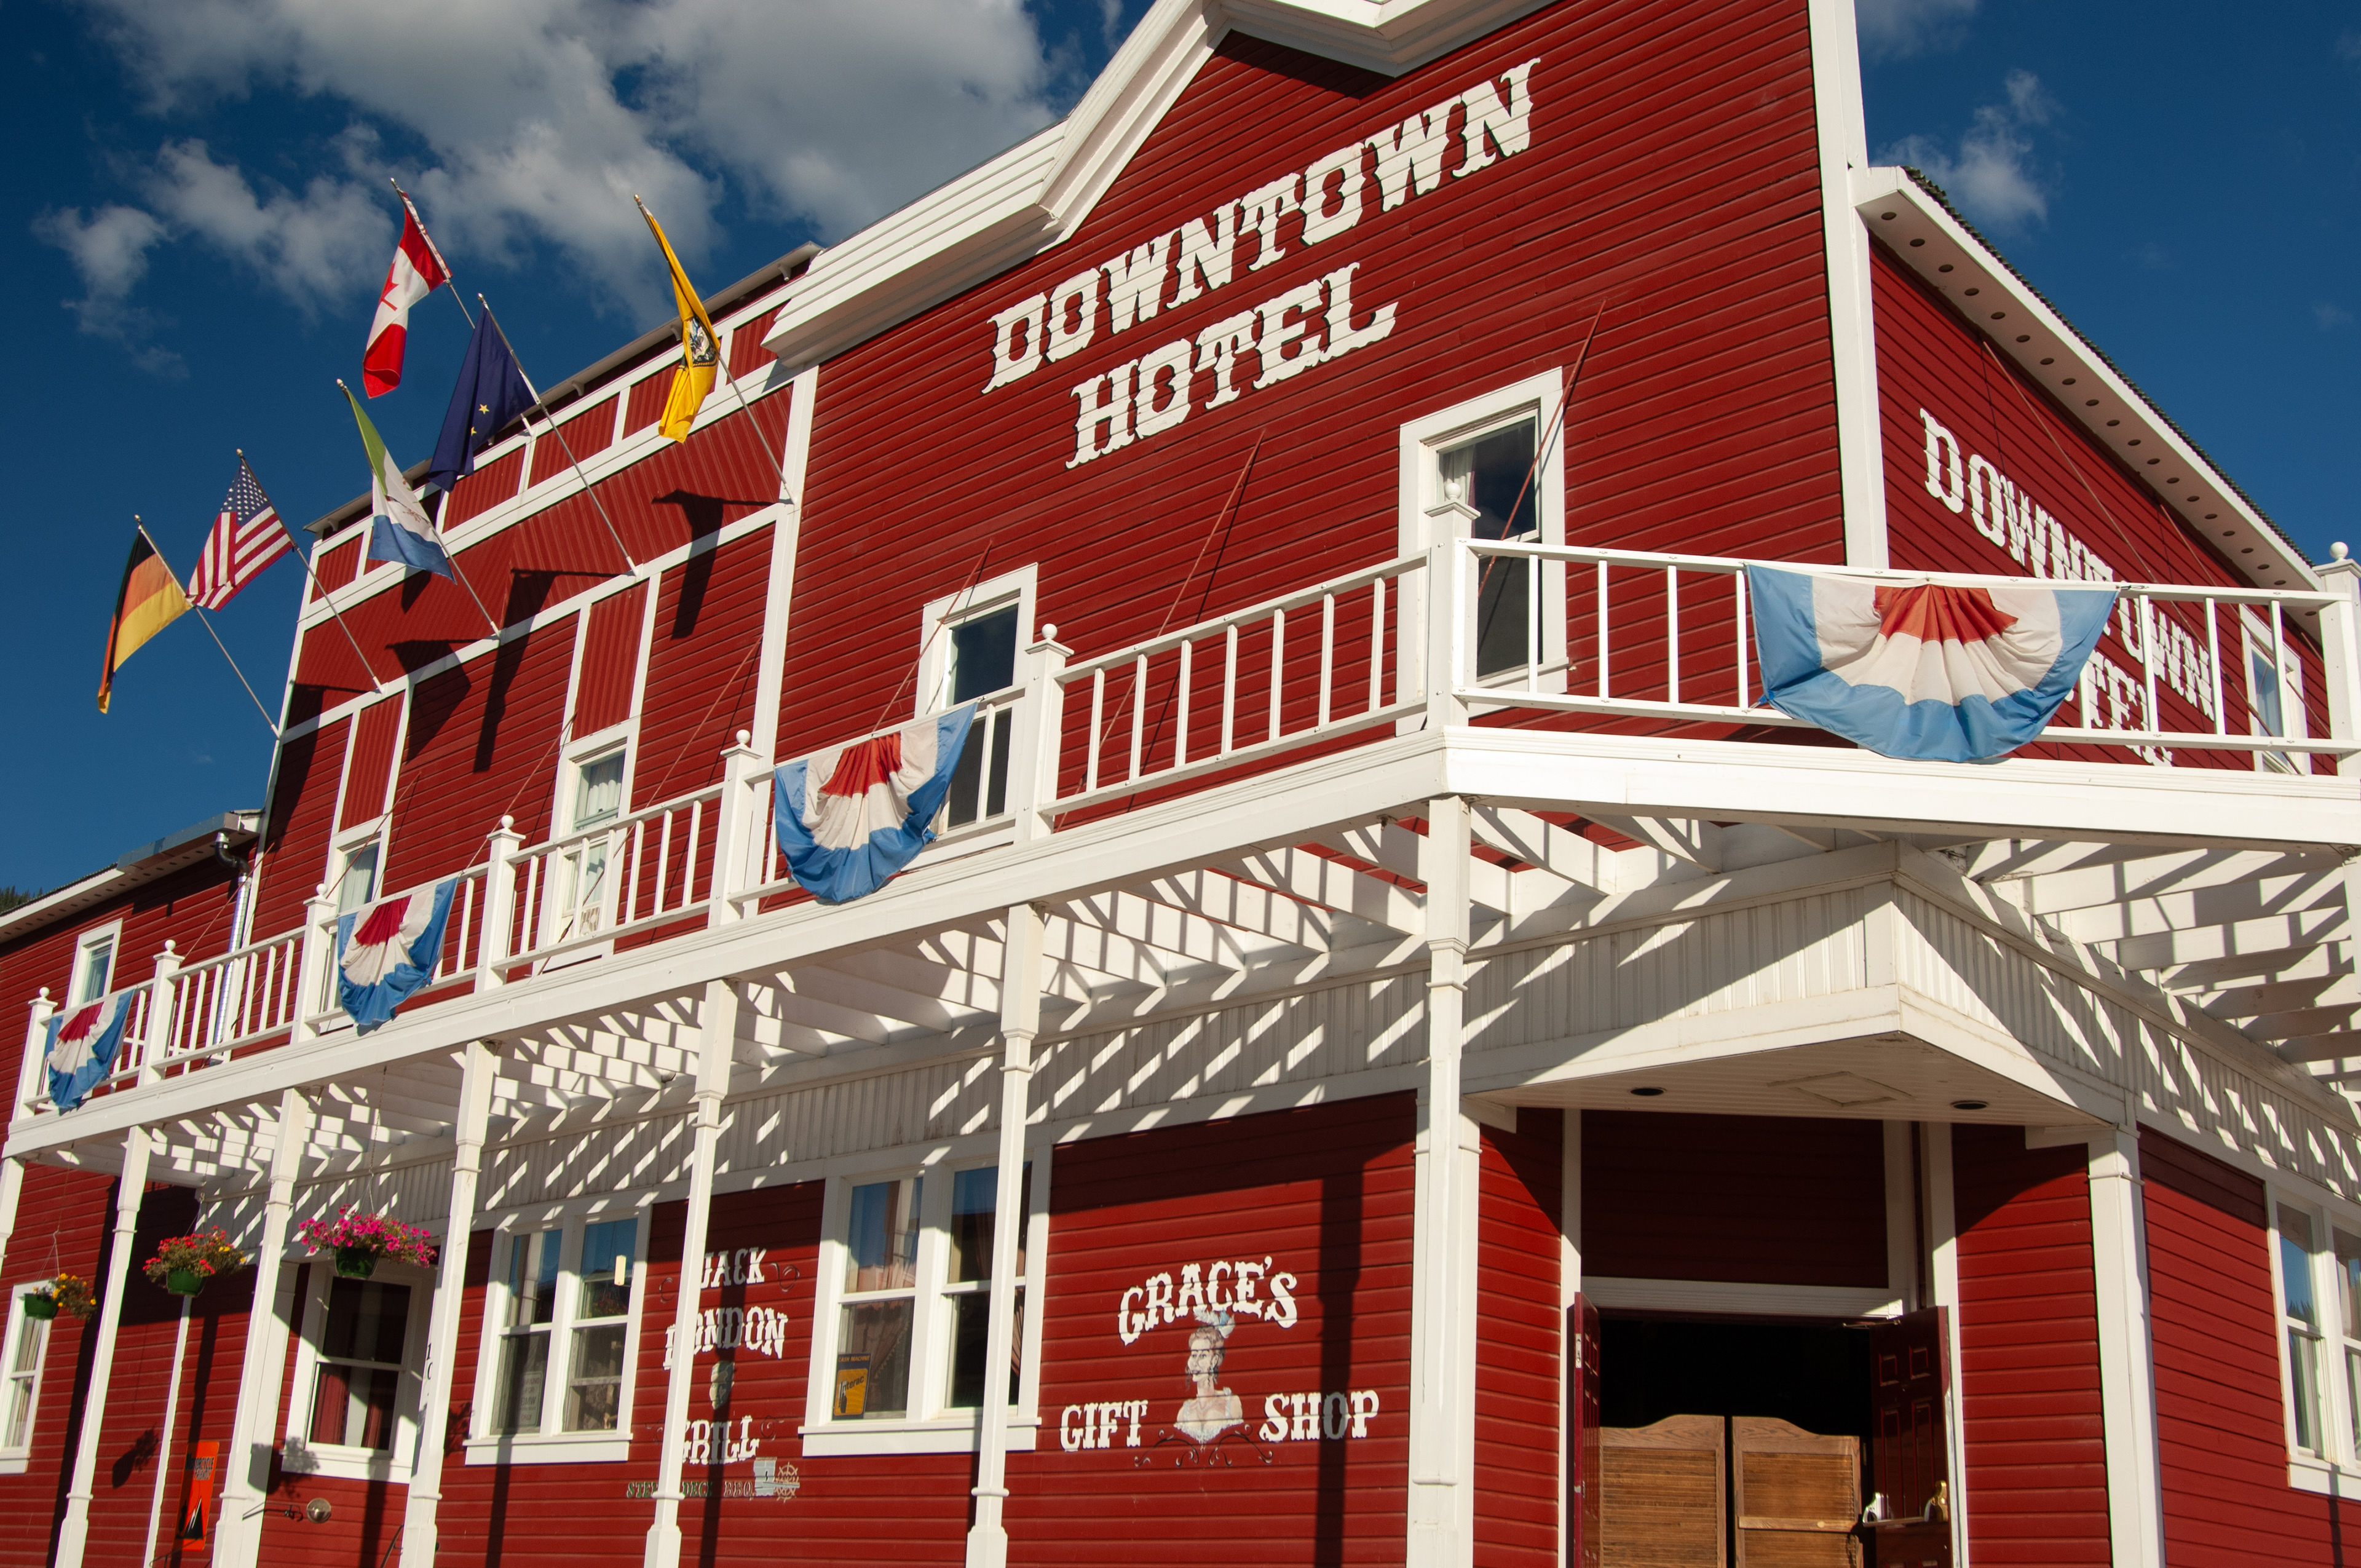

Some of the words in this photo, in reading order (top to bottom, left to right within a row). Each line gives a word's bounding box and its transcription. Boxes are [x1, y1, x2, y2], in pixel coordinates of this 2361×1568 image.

[982, 58, 1541, 394] DOWNTOWN
[1066, 263, 1398, 469] HOTEL
[700, 1246, 767, 1289] JACK
[1117, 1256, 1298, 1346] GRACE'S
[839, 1376, 864, 1395] Interac
[1060, 1400, 1149, 1452] GIFT
[1259, 1390, 1380, 1443] SHOP
[723, 1480, 756, 1501] BBQ
